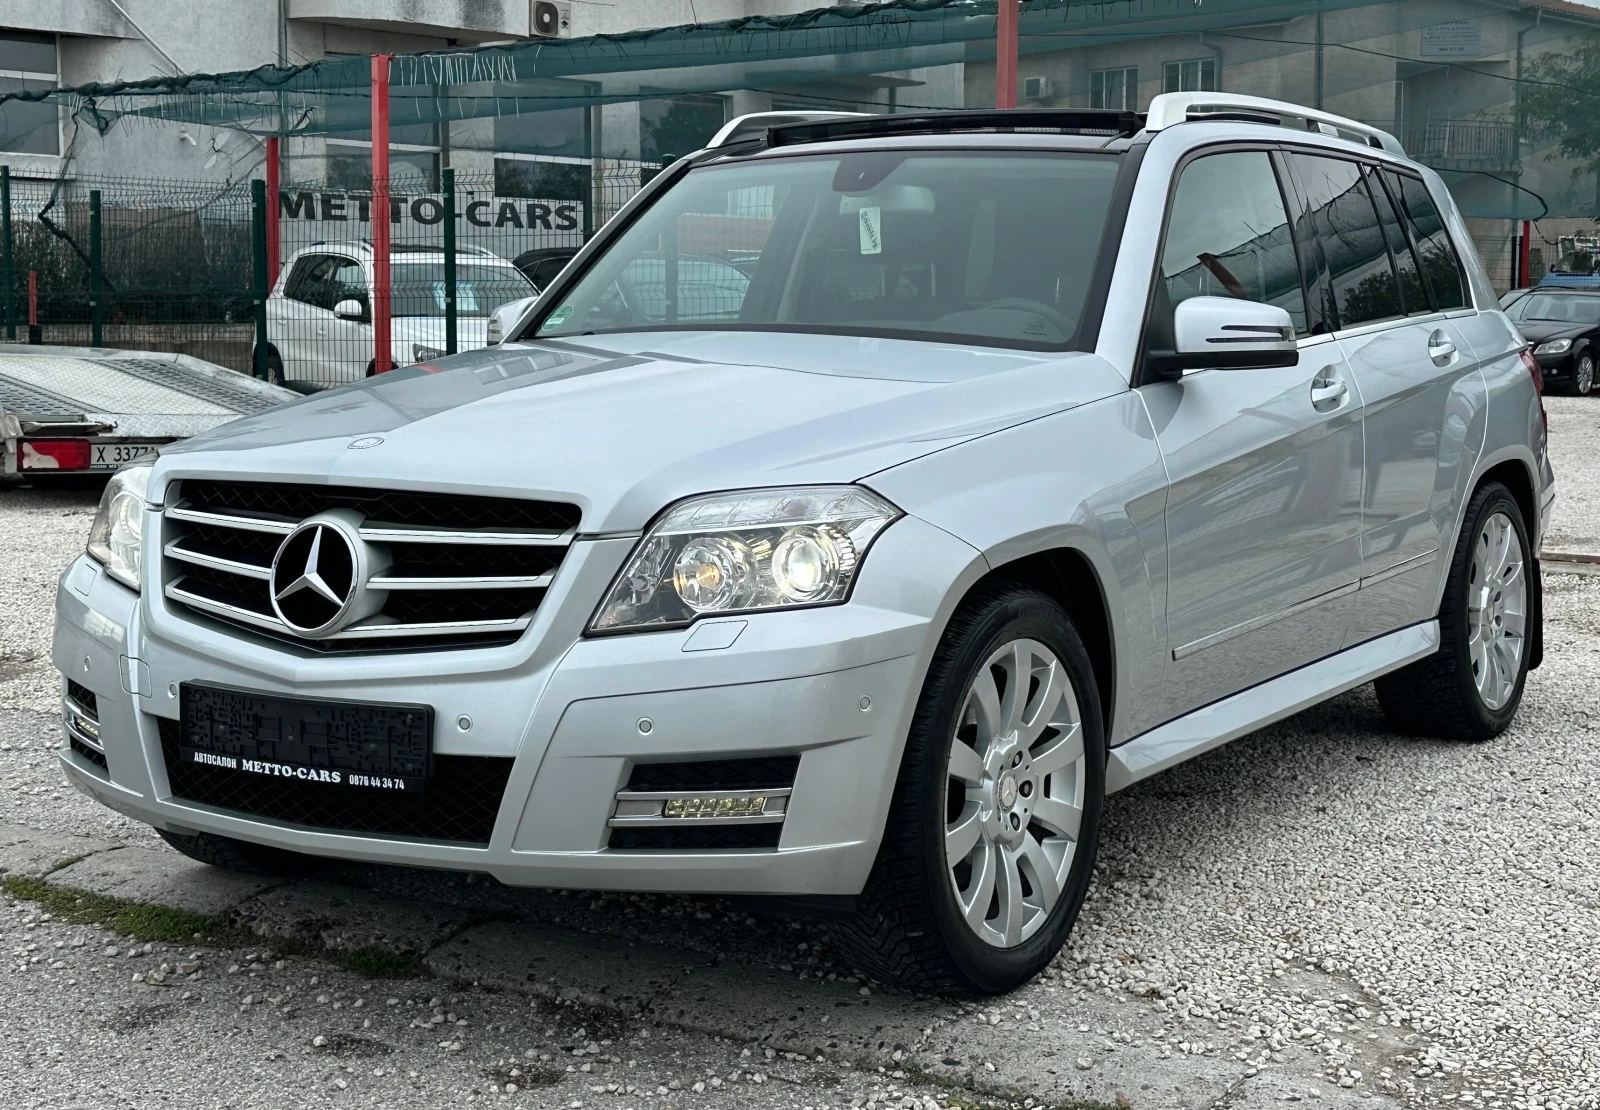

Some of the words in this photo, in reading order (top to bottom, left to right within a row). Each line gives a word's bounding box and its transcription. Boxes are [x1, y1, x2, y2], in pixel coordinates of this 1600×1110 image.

[278, 190, 578, 231] METTO-CARS
[96, 446, 106, 462] X
[194, 751, 237, 769] АВТОСАЛОН
[242, 758, 342, 784] METTO-CARS
[349, 774, 369, 787] 0876
[370, 776, 381, 788] 44
[382, 777, 393, 789] 34
[393, 778, 405, 790] 74
